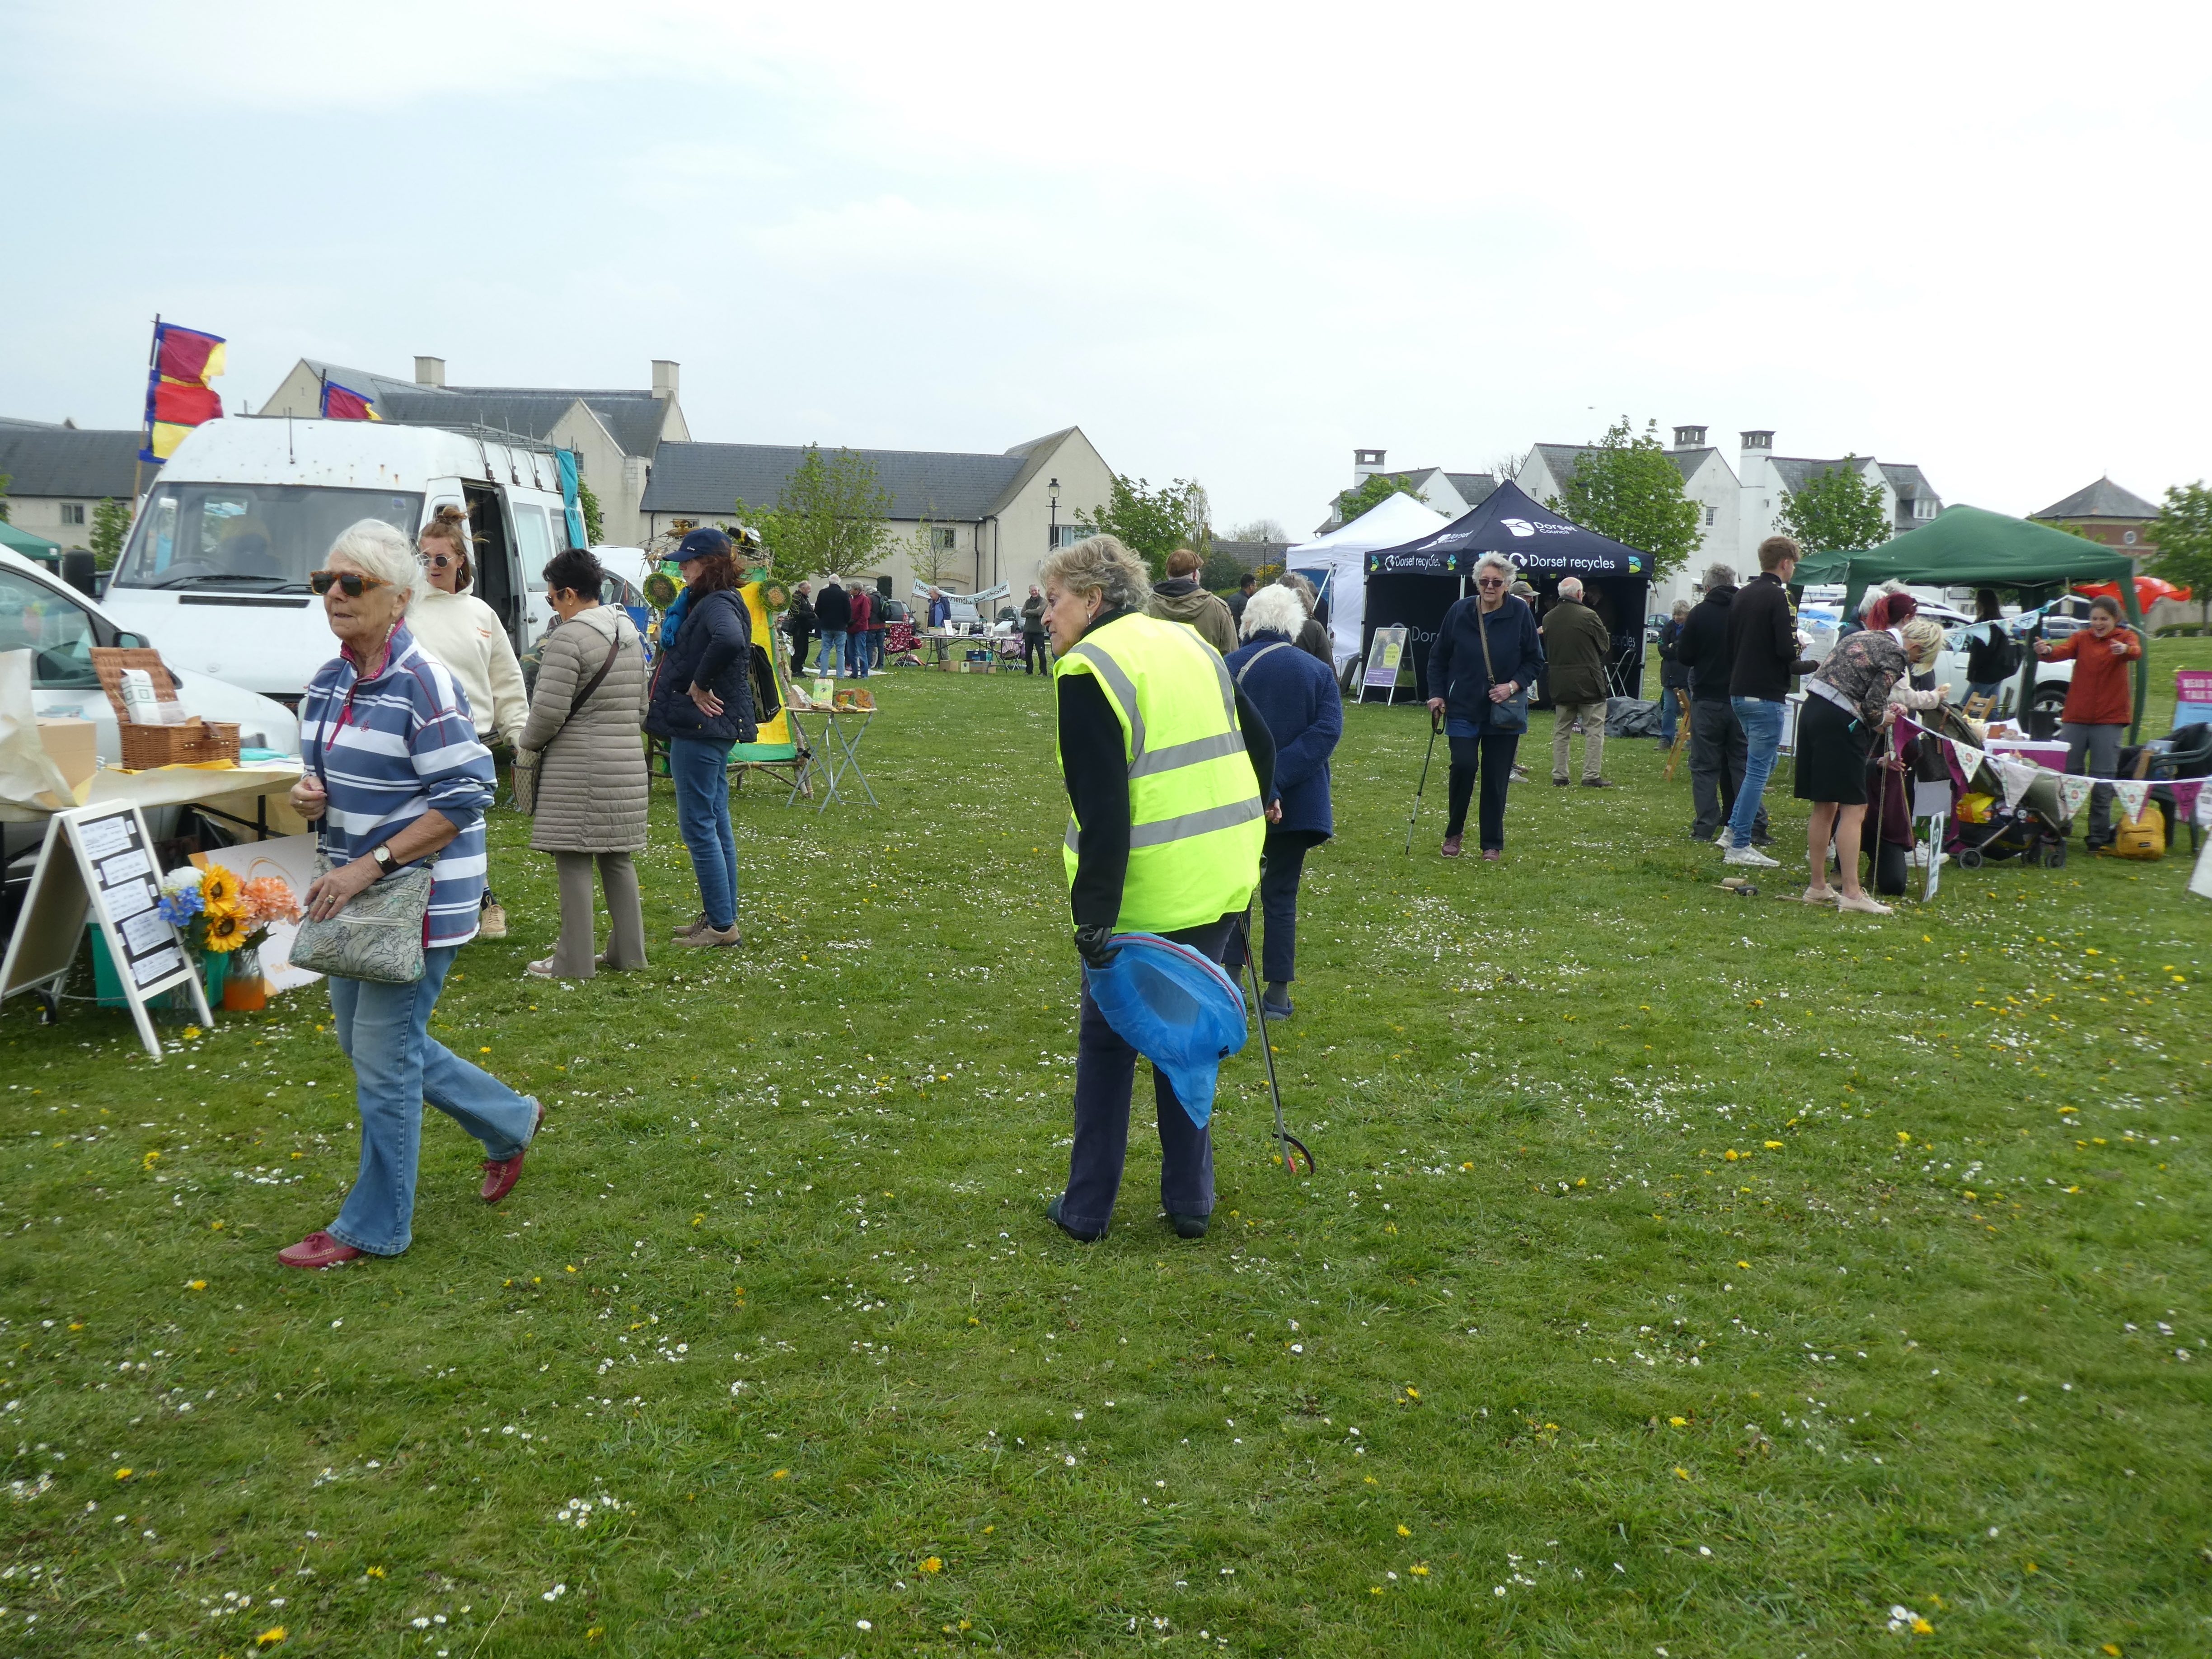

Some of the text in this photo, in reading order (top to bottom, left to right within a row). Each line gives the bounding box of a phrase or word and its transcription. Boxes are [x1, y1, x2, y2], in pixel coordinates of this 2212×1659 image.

[1533, 521, 1578, 532] Dorset
[1394, 554, 1440, 570] Dorset recycles
[1530, 554, 1615, 572] Dorset recycles
[1612, 629, 1636, 650] ecycles
